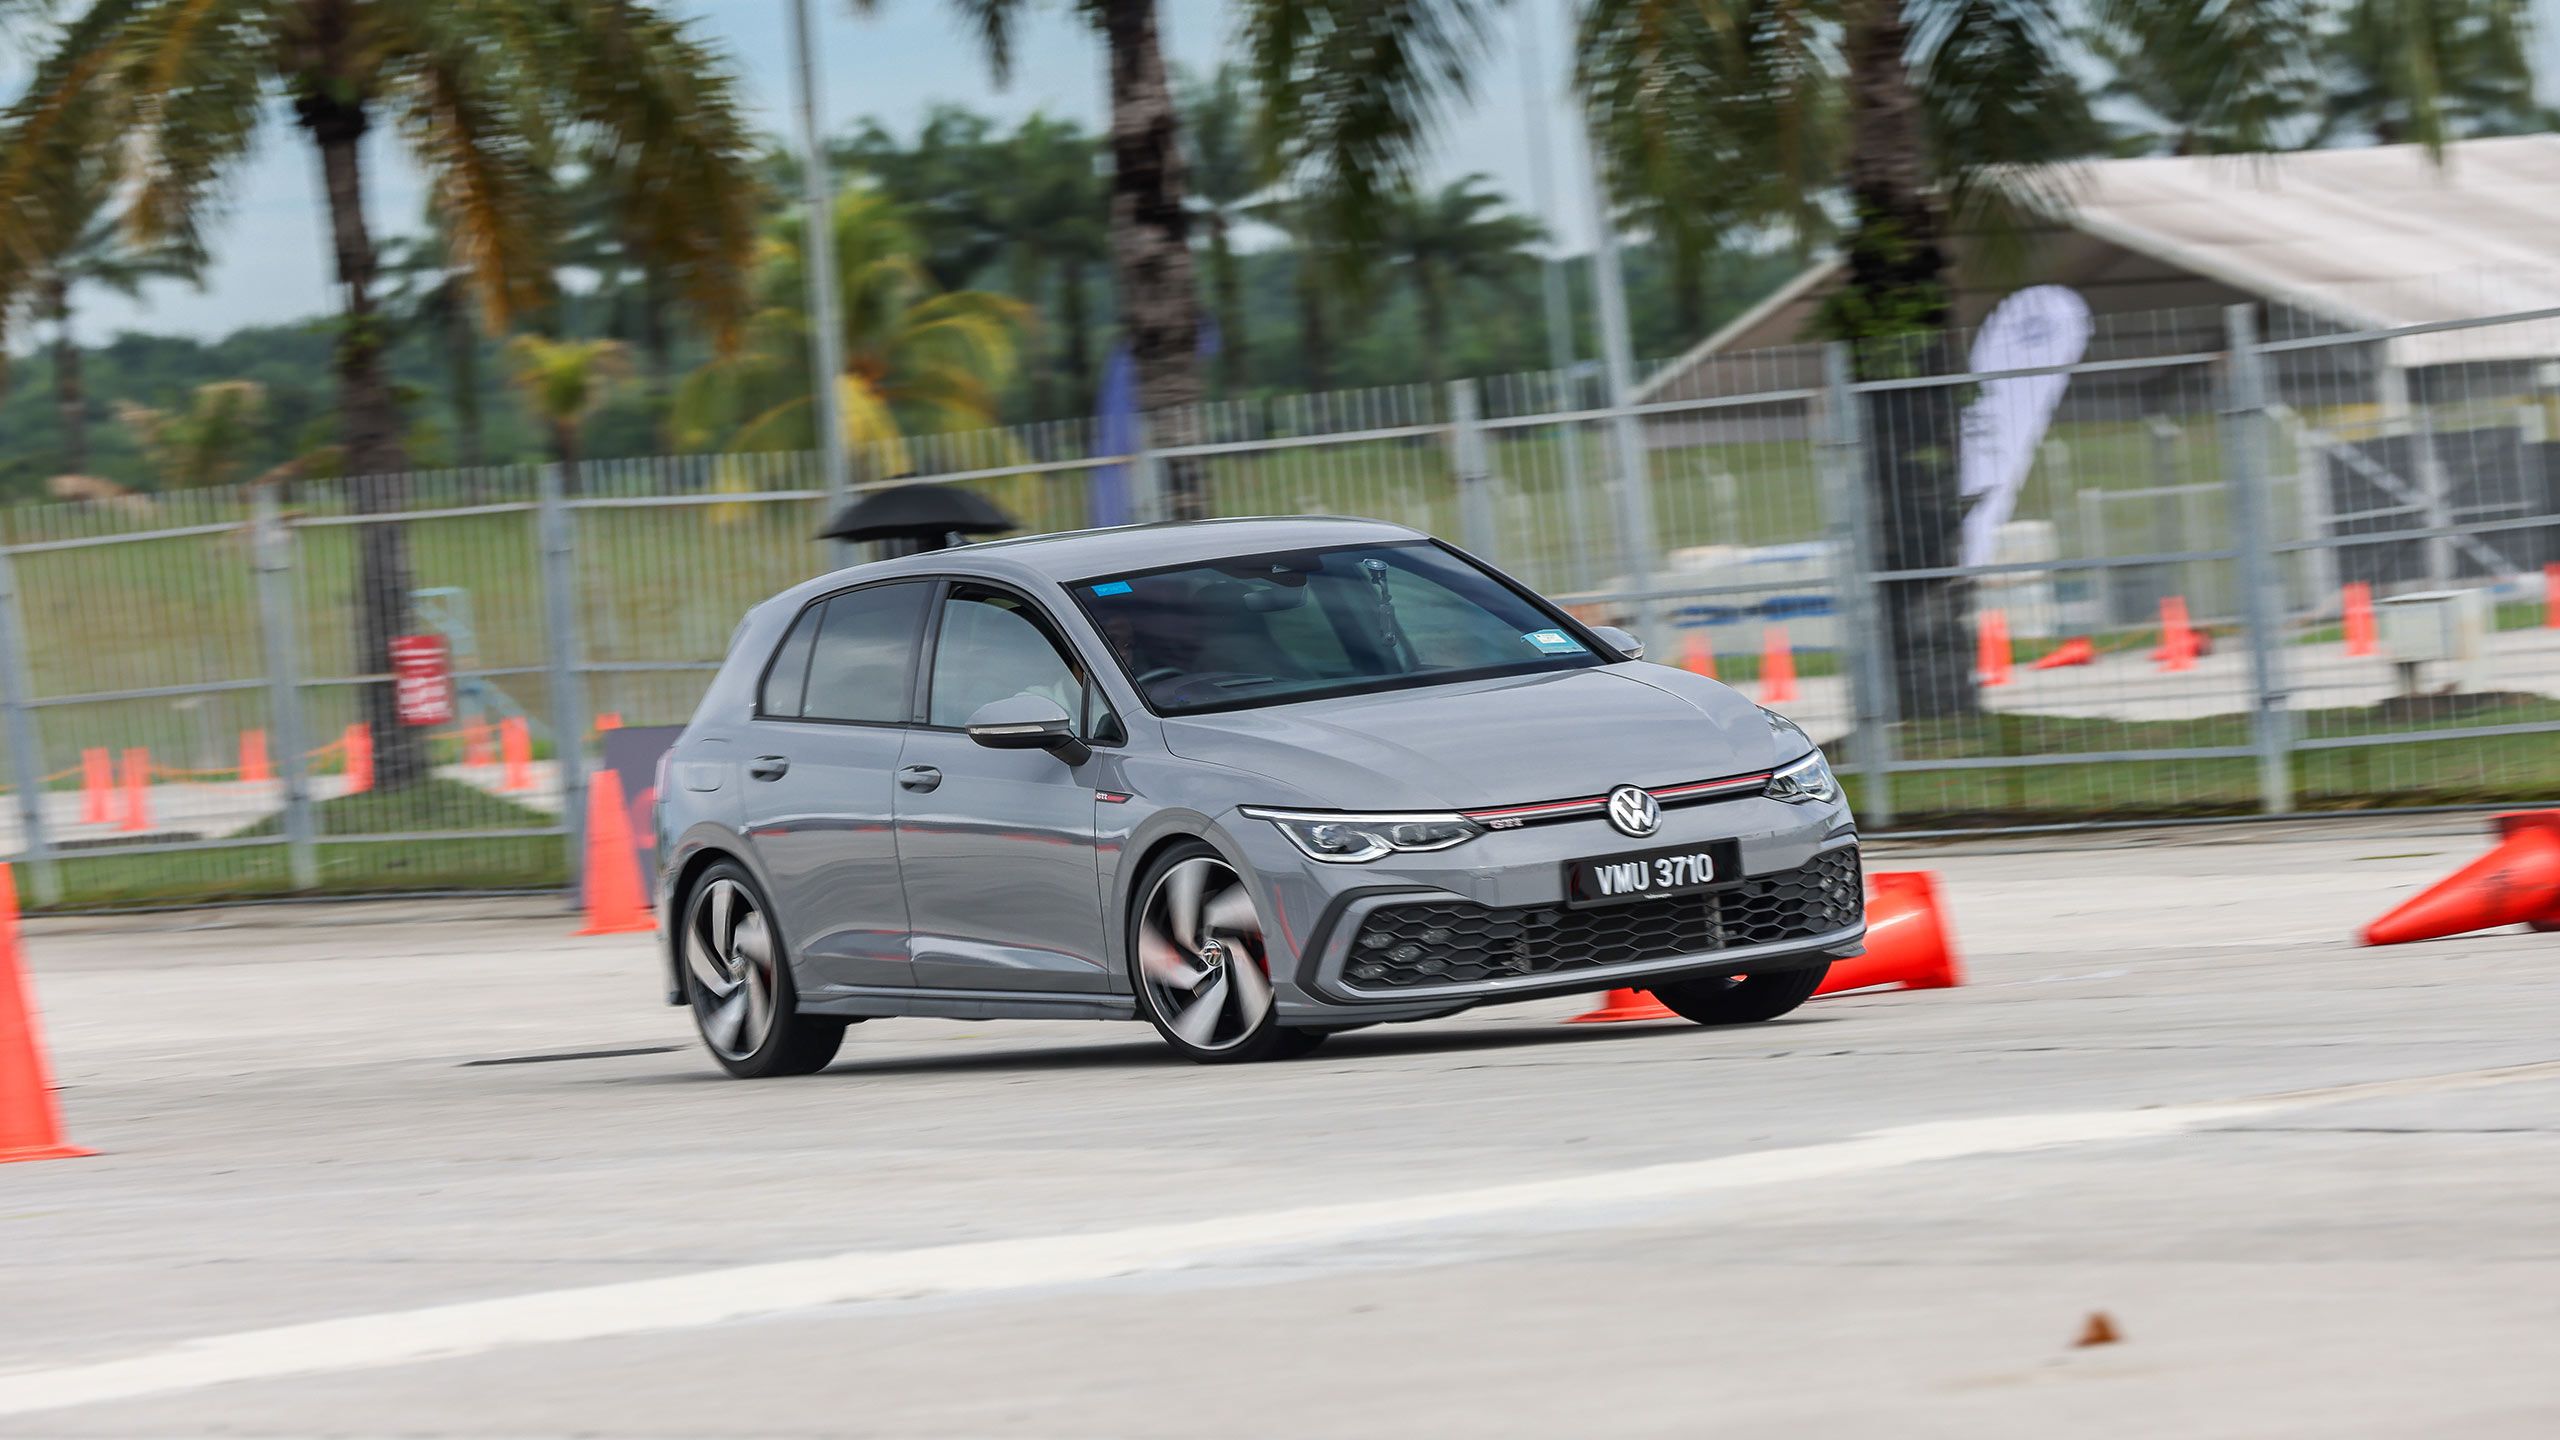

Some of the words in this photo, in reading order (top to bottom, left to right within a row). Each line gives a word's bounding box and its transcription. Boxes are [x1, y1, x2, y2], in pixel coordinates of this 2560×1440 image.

[1489, 817, 1524, 829] GTI
[1594, 861, 1650, 895] VMU
[1654, 853, 1715, 888] 3710
